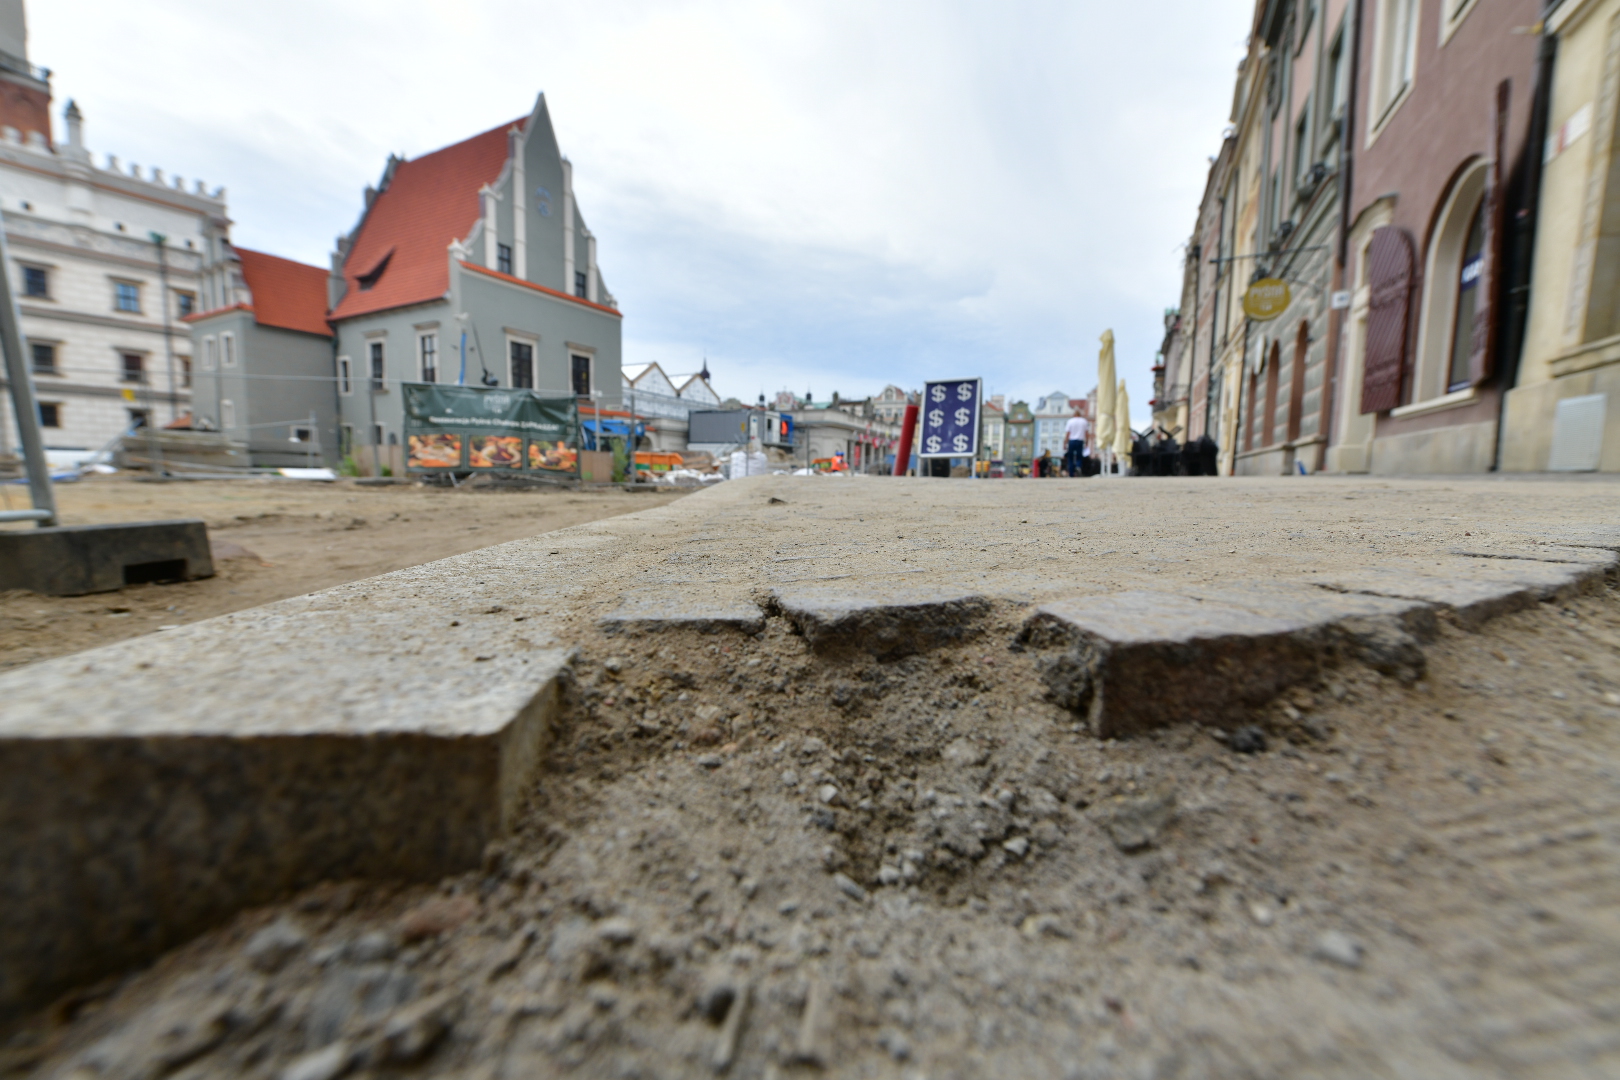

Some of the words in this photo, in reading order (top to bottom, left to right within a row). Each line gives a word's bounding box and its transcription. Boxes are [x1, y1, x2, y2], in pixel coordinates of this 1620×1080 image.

[931, 384, 947, 403] $
[956, 382, 973, 402] $
[928, 408, 945, 428] $
[954, 406, 971, 427] $
[926, 434, 942, 453] $
[952, 433, 969, 453] $
